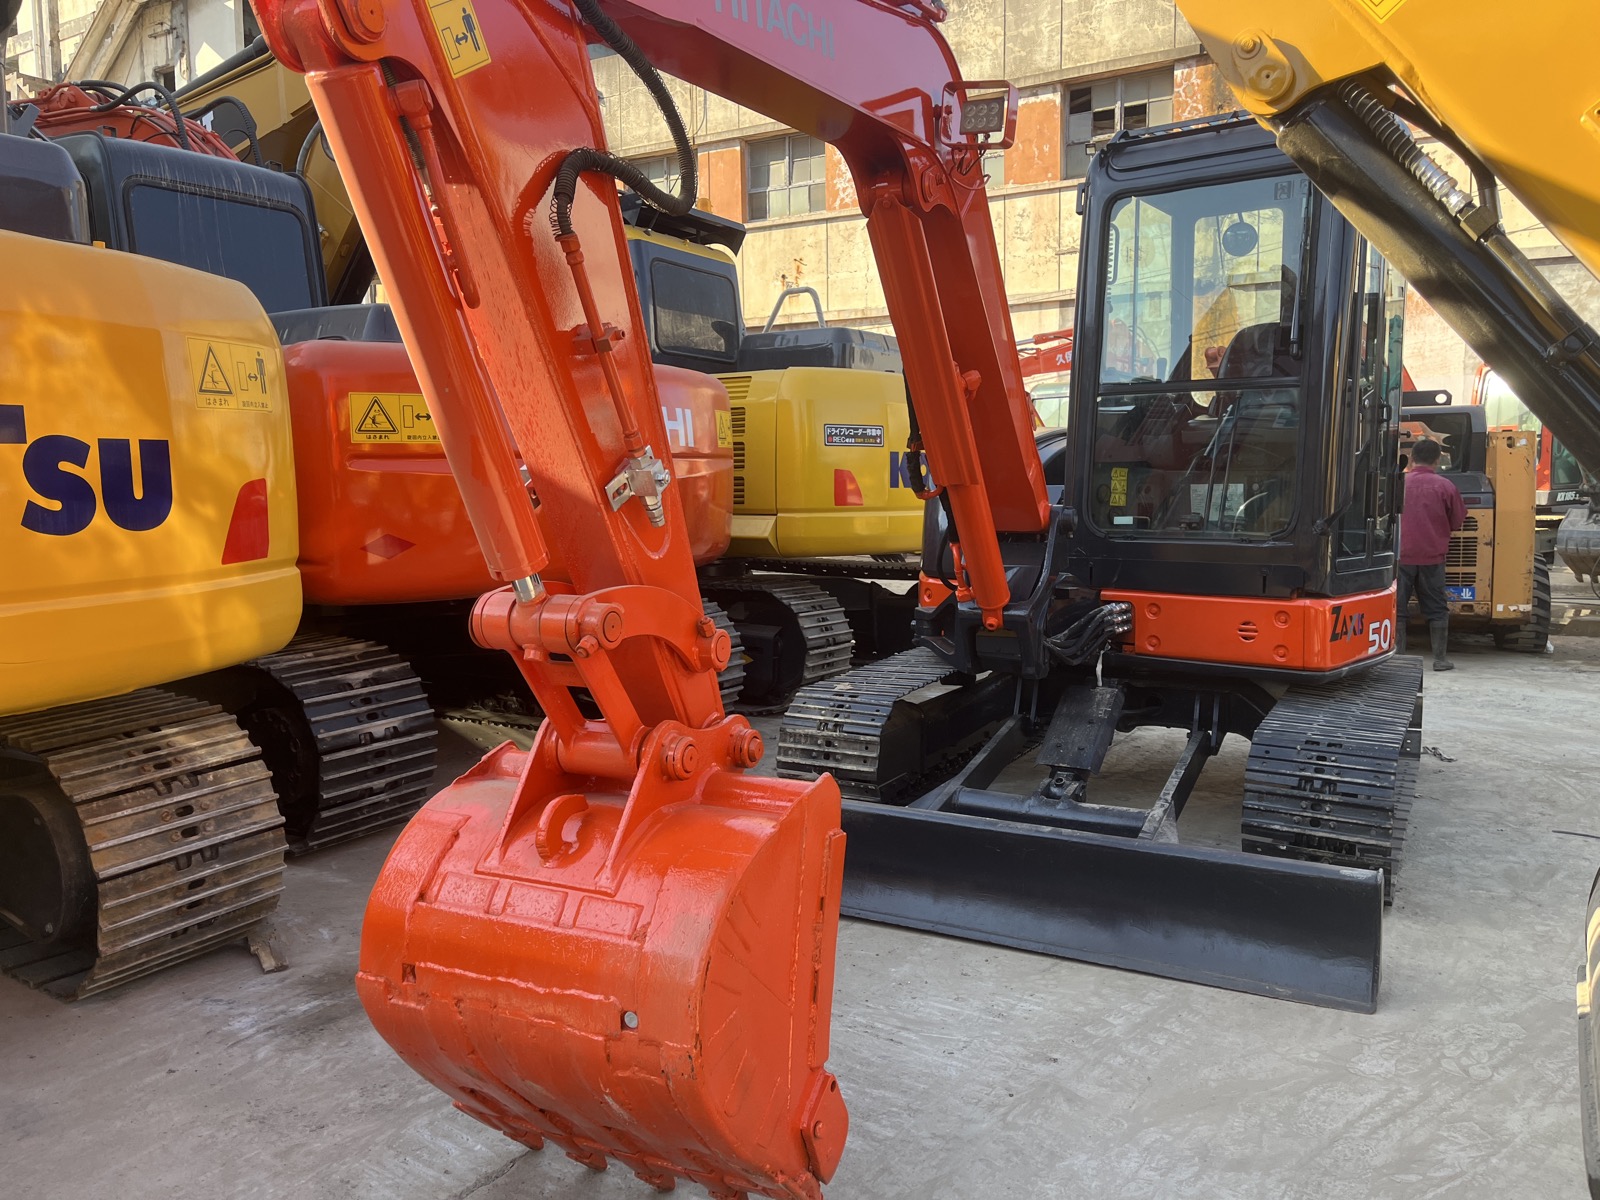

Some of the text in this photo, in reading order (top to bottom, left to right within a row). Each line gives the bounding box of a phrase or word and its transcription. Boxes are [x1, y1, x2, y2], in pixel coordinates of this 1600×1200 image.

[205, 397, 230, 407] はさまれ
[1329, 605, 1391, 655] ZAXIS 50
